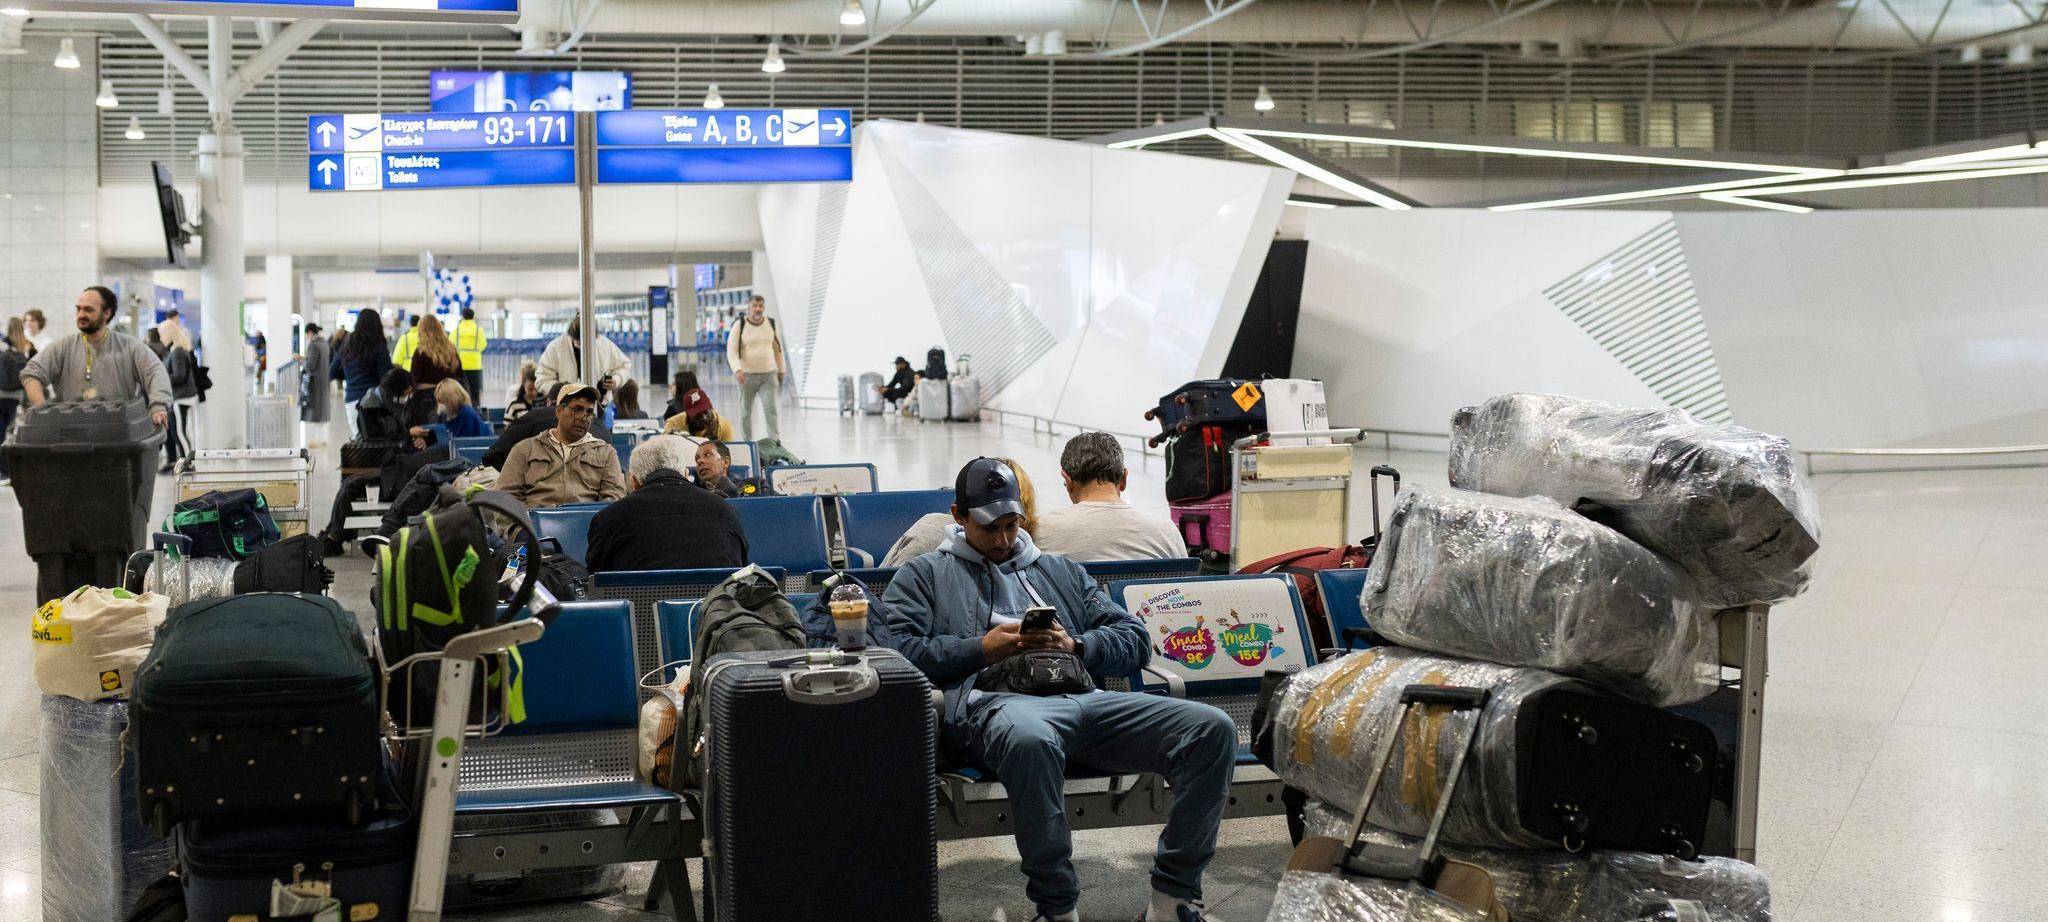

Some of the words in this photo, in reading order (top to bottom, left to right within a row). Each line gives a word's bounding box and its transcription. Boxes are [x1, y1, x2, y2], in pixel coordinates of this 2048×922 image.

[484, 116, 566, 145] 93-171
[765, 114, 782, 142] C
[384, 134, 424, 146] Check-in
[665, 130, 692, 142] Gates
[387, 155, 440, 169] Τουαλέτες
[388, 171, 419, 183] Toilets
[1148, 588, 1181, 605] DISCOVER
[1167, 594, 1185, 604] NOW
[1156, 604, 1171, 612] THE
[1171, 599, 1202, 609] COMBOS
[1170, 628, 1206, 649] Snack
[1224, 623, 1259, 646] Meal
[1182, 643, 1208, 652] COMBO
[1239, 640, 1265, 648] COMBO
[1186, 652, 1205, 664] 9€
[1238, 649, 1261, 661] 15€
